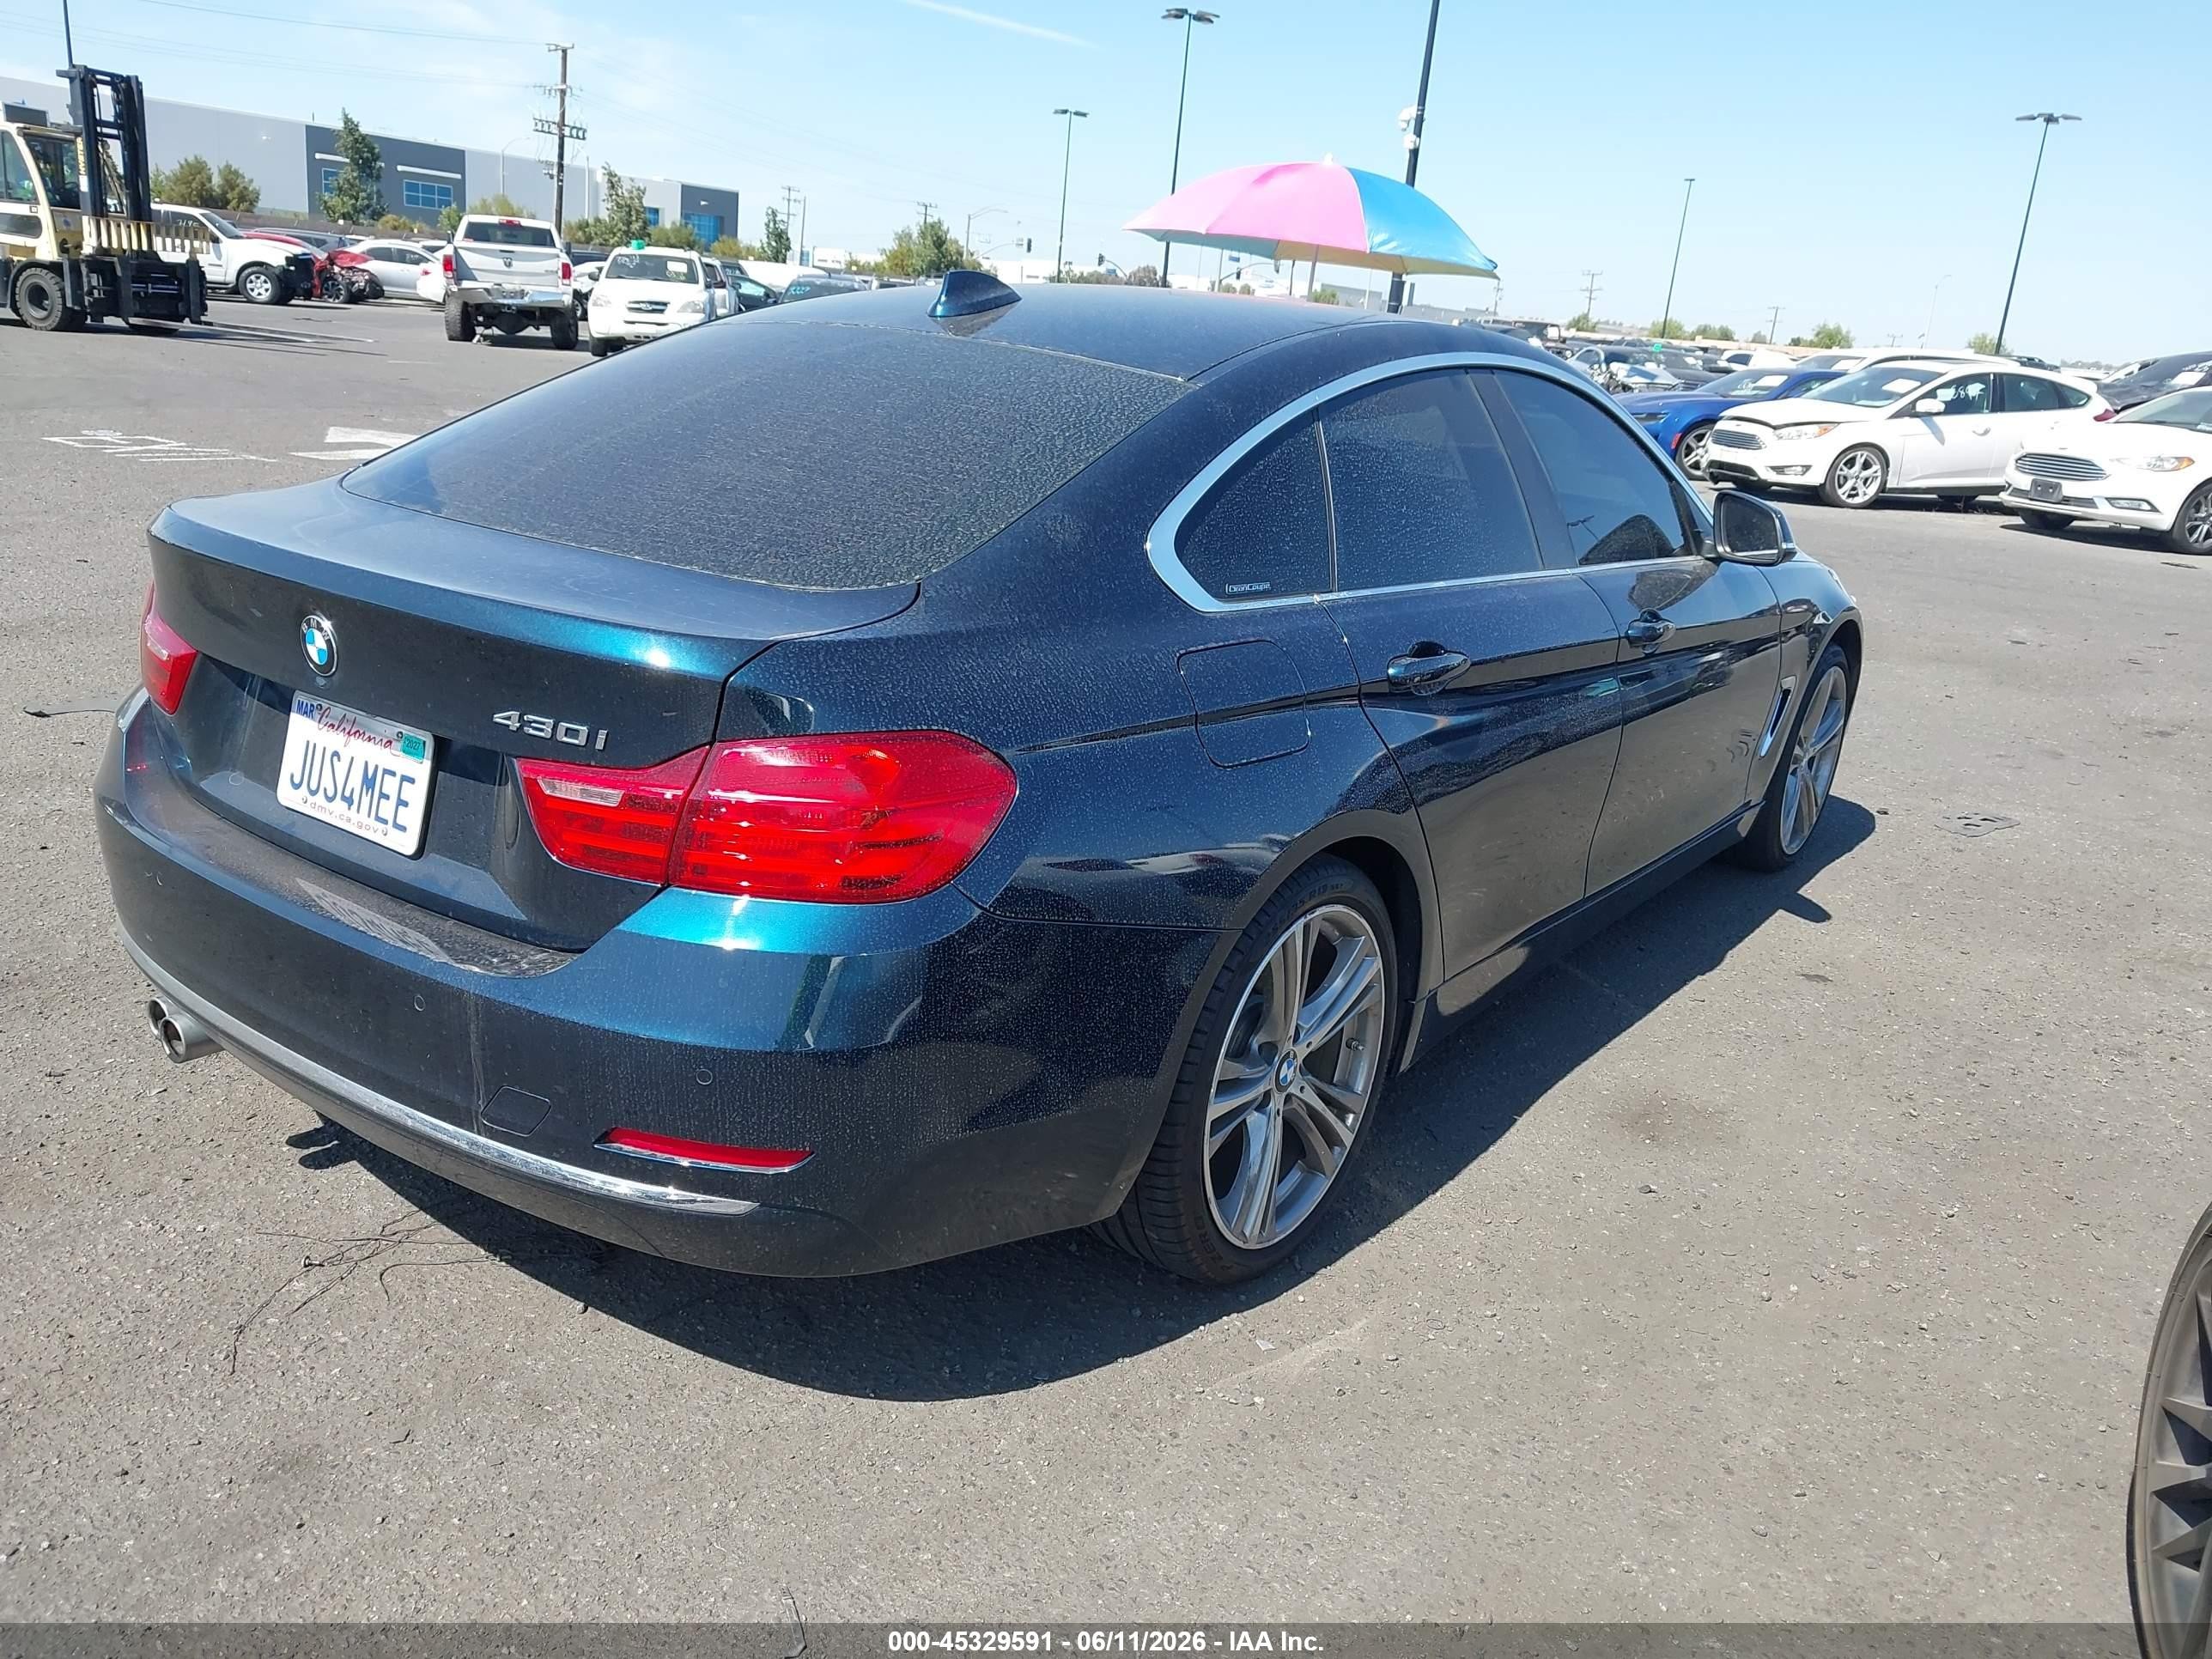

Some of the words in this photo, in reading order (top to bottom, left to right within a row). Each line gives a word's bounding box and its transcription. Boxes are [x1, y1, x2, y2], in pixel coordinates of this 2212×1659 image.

[301, 617, 331, 641] BMW
[296, 699, 316, 720] MAR
[317, 707, 398, 752] California
[492, 710, 608, 750] 430i
[289, 739, 416, 834] JUS4MEE
[309, 801, 380, 835] dmv.ca.gov
